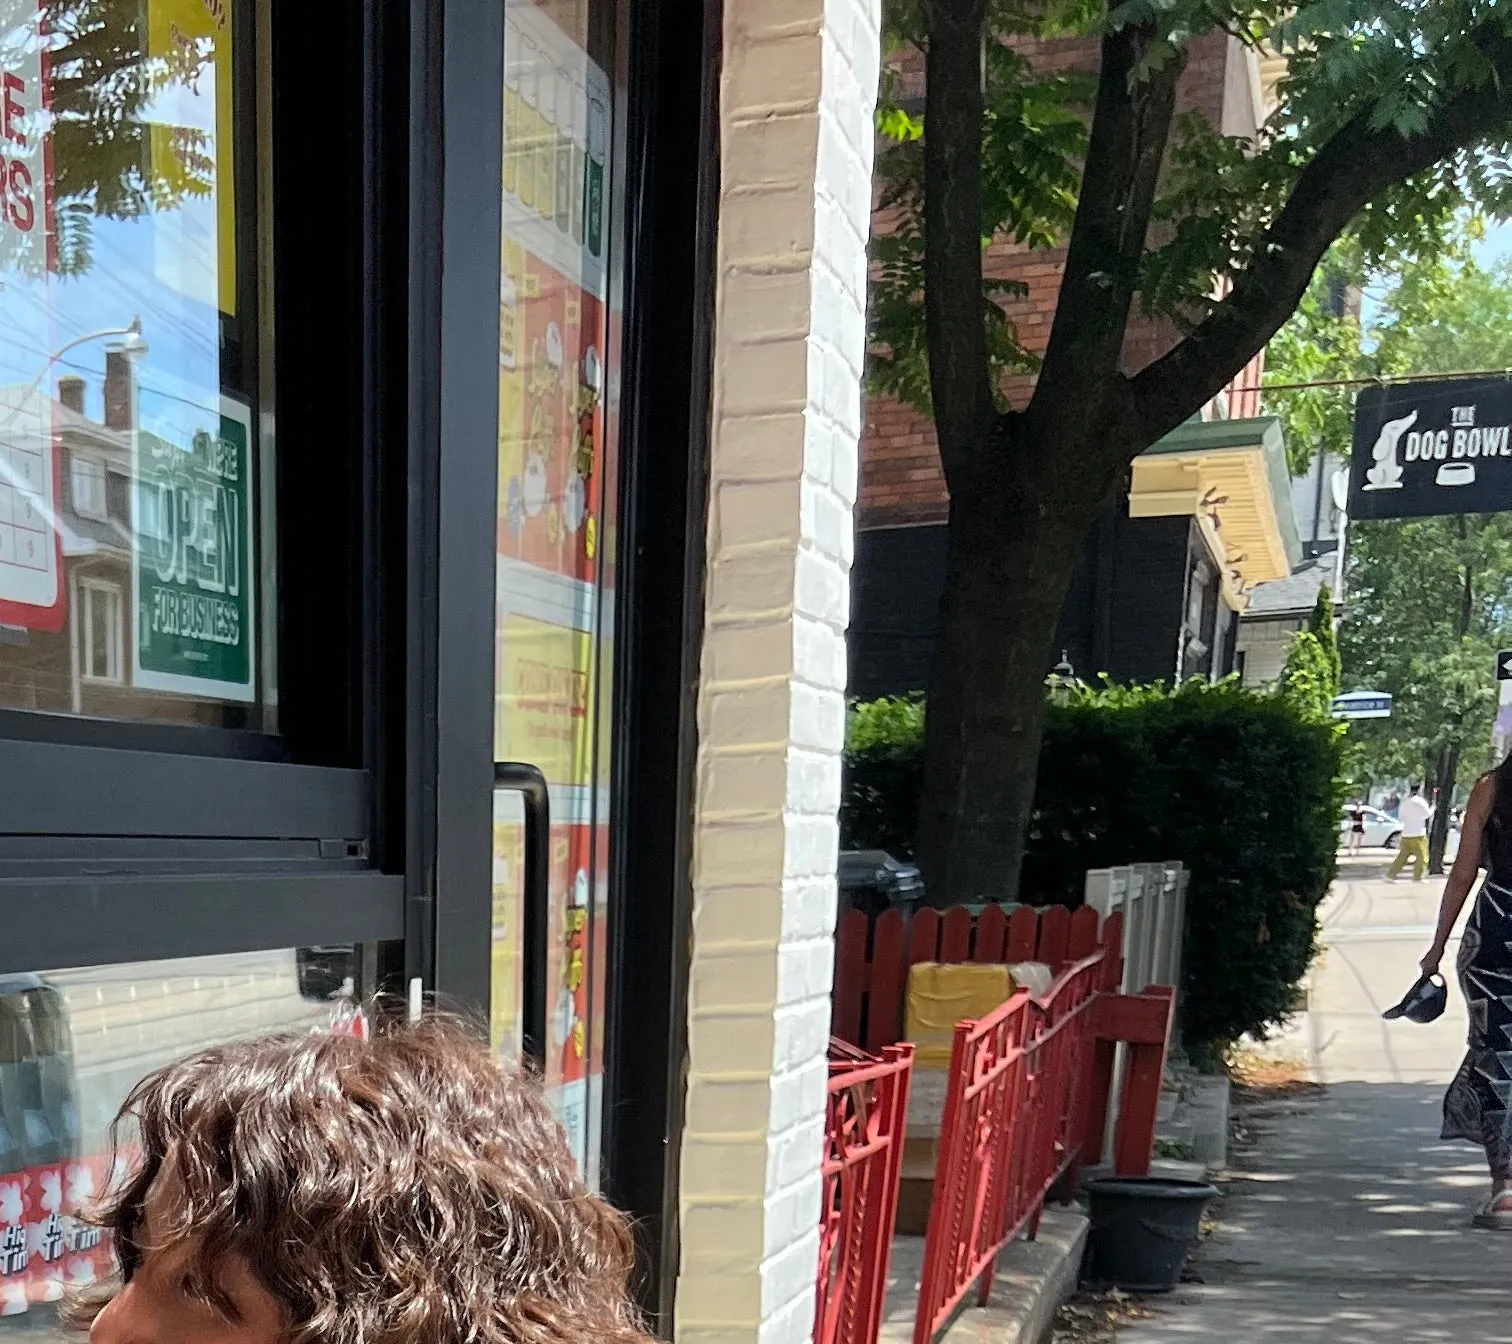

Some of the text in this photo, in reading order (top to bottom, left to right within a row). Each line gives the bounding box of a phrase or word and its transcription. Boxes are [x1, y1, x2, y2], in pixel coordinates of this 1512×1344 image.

[1450, 404, 1477, 427] THE
[1405, 424, 1512, 462] DOG BOWL
[152, 463, 239, 597] OPEN
[152, 585, 240, 647] FOR BUSINESS
